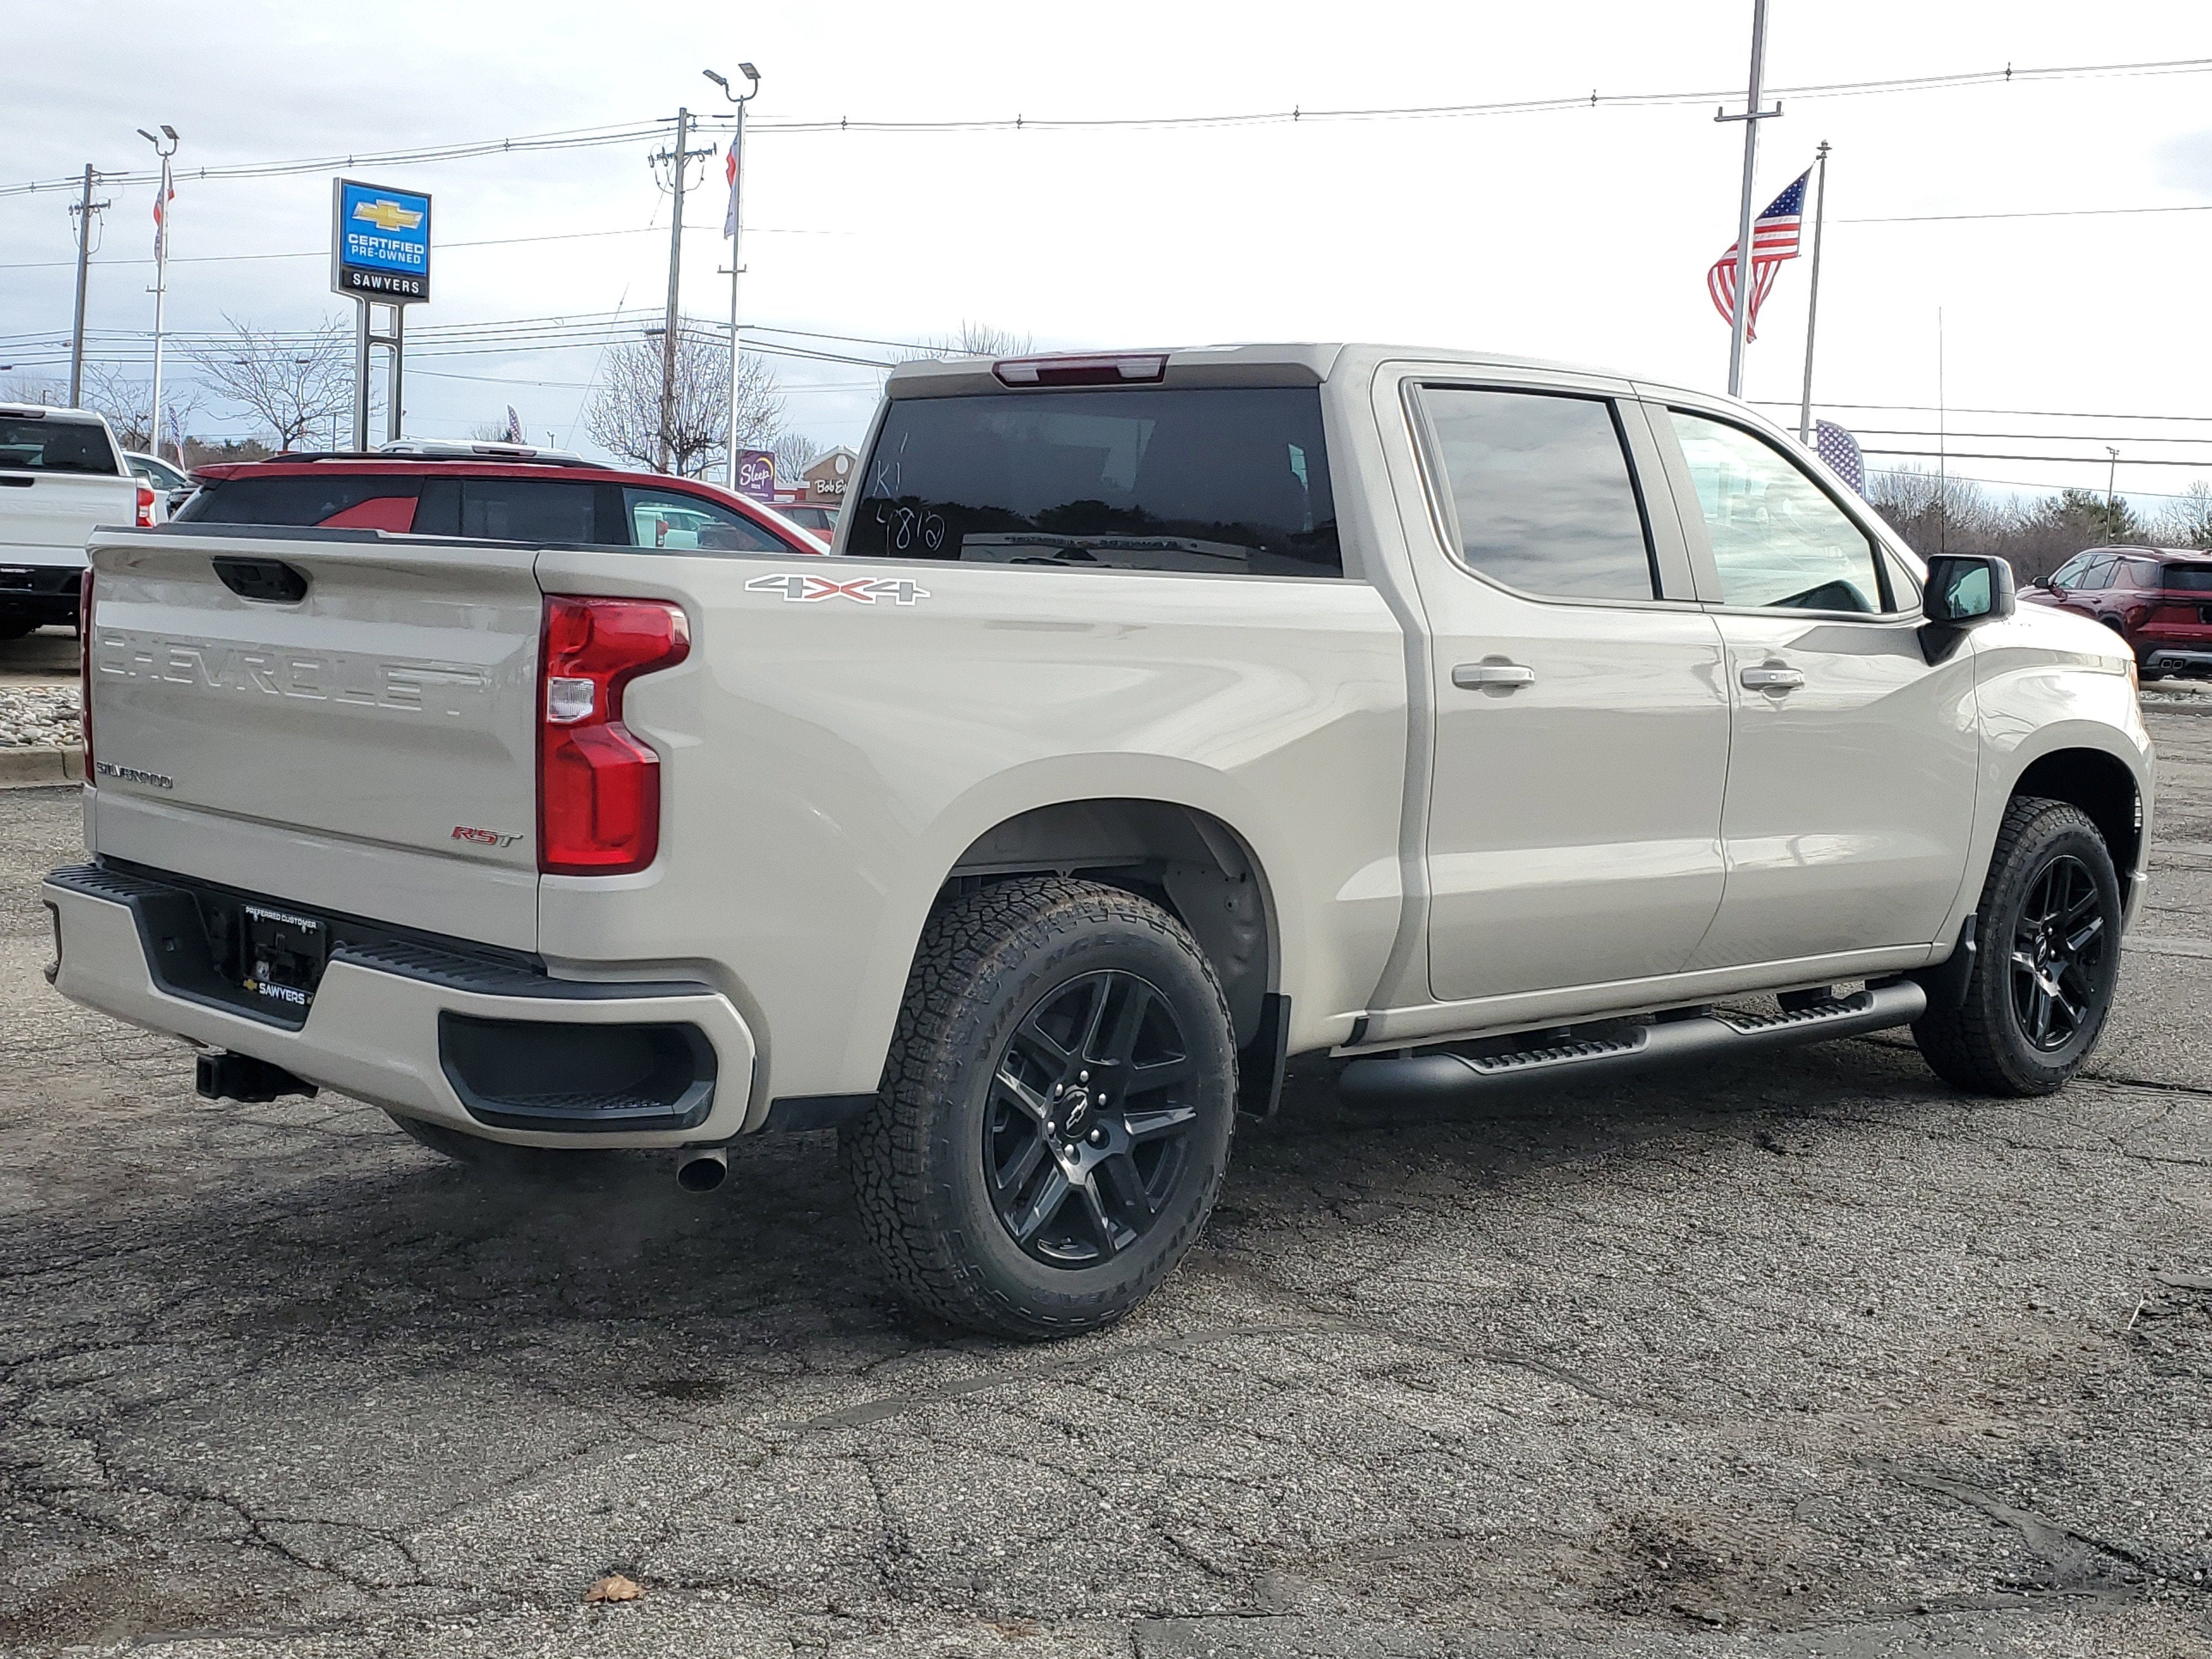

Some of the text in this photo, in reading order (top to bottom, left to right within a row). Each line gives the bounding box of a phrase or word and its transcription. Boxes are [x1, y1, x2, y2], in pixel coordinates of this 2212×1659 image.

[349, 233, 424, 254] CERTIFIED
[352, 246, 421, 264] PRE-OWNED
[353, 273, 419, 293] SAWYERS
[740, 464, 770, 487] Sleep
[814, 479, 834, 493] Bob
[451, 825, 524, 848] RST
[245, 906, 317, 929] PREFERRED CUSTOMER
[259, 983, 305, 1005] SAWYERS
